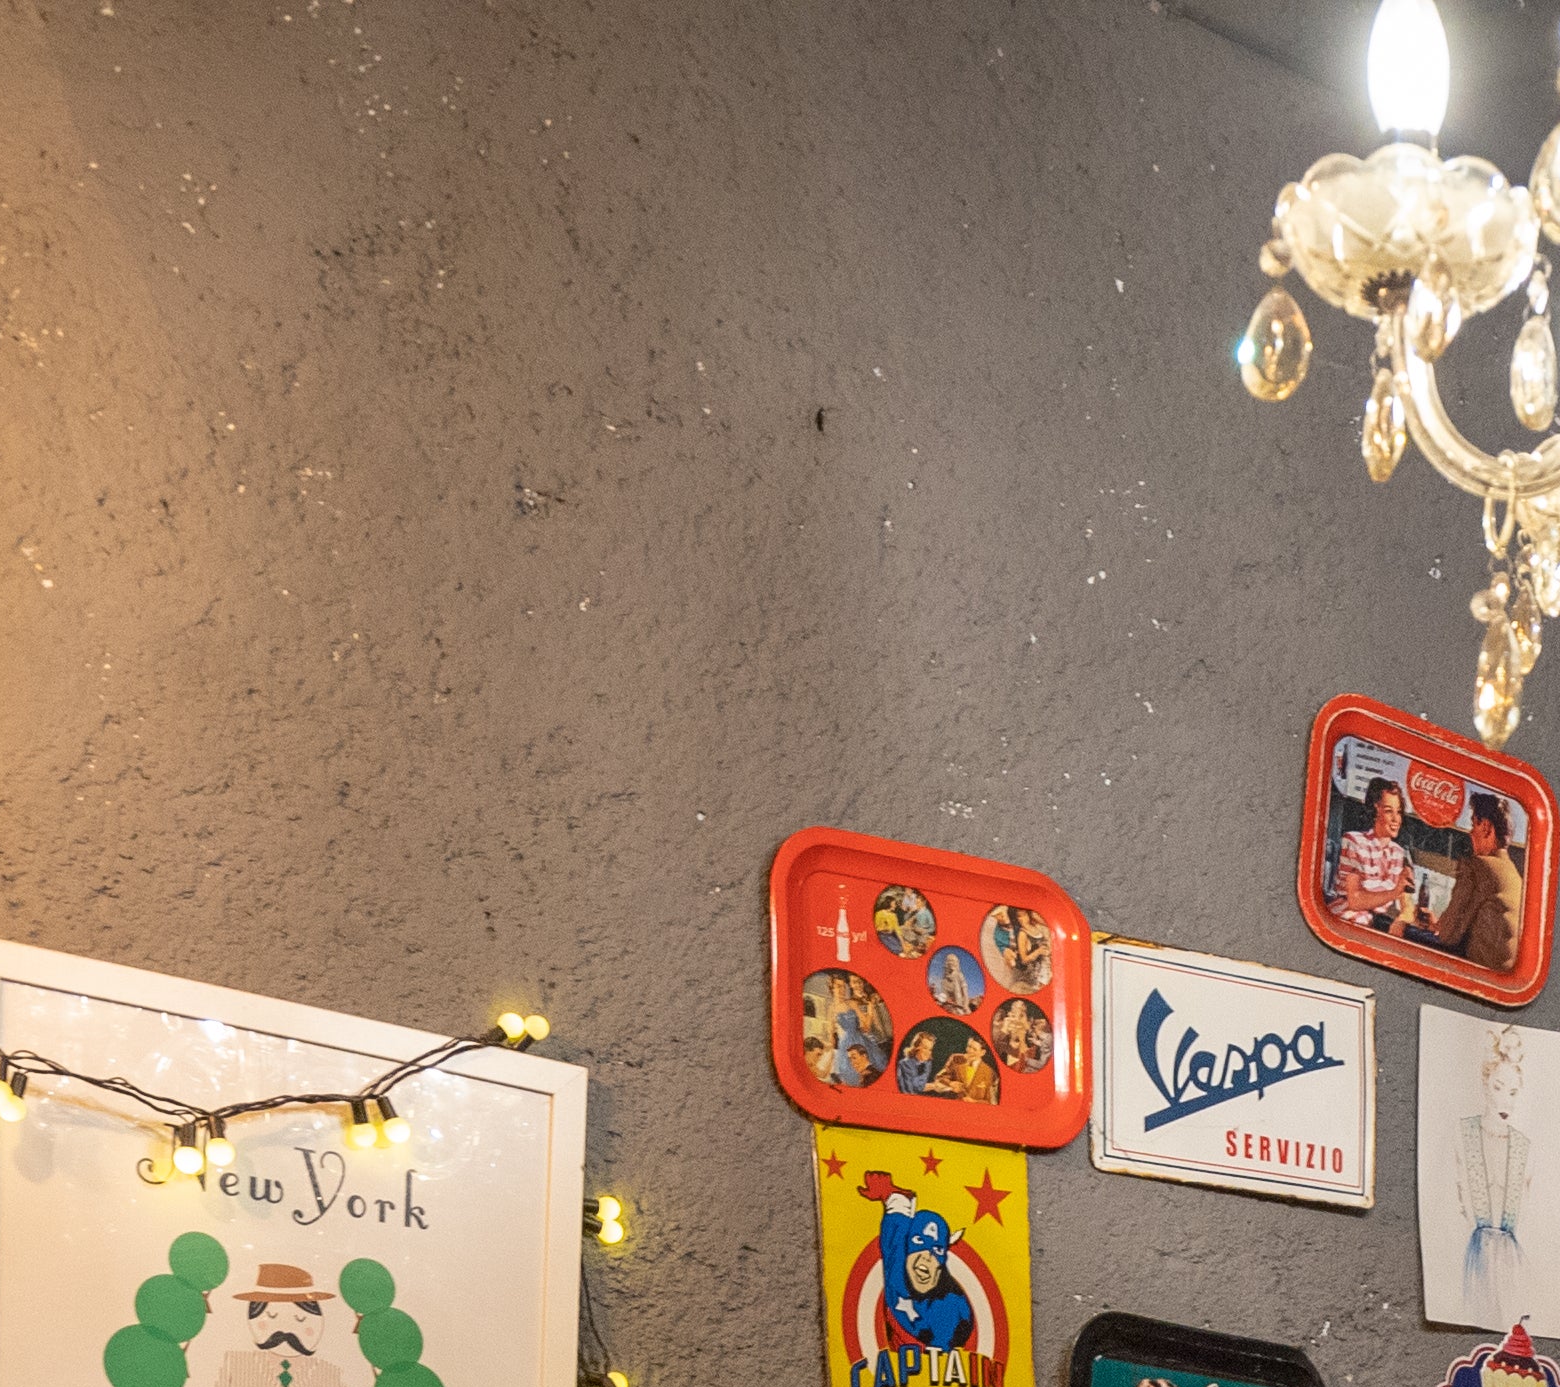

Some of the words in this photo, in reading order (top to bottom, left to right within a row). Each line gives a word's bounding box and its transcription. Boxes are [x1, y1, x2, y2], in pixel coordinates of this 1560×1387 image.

[1136, 987, 1345, 1133] Vespa
[292, 1147, 430, 1230] York
[1226, 1130, 1344, 1174] SERVIZIO
